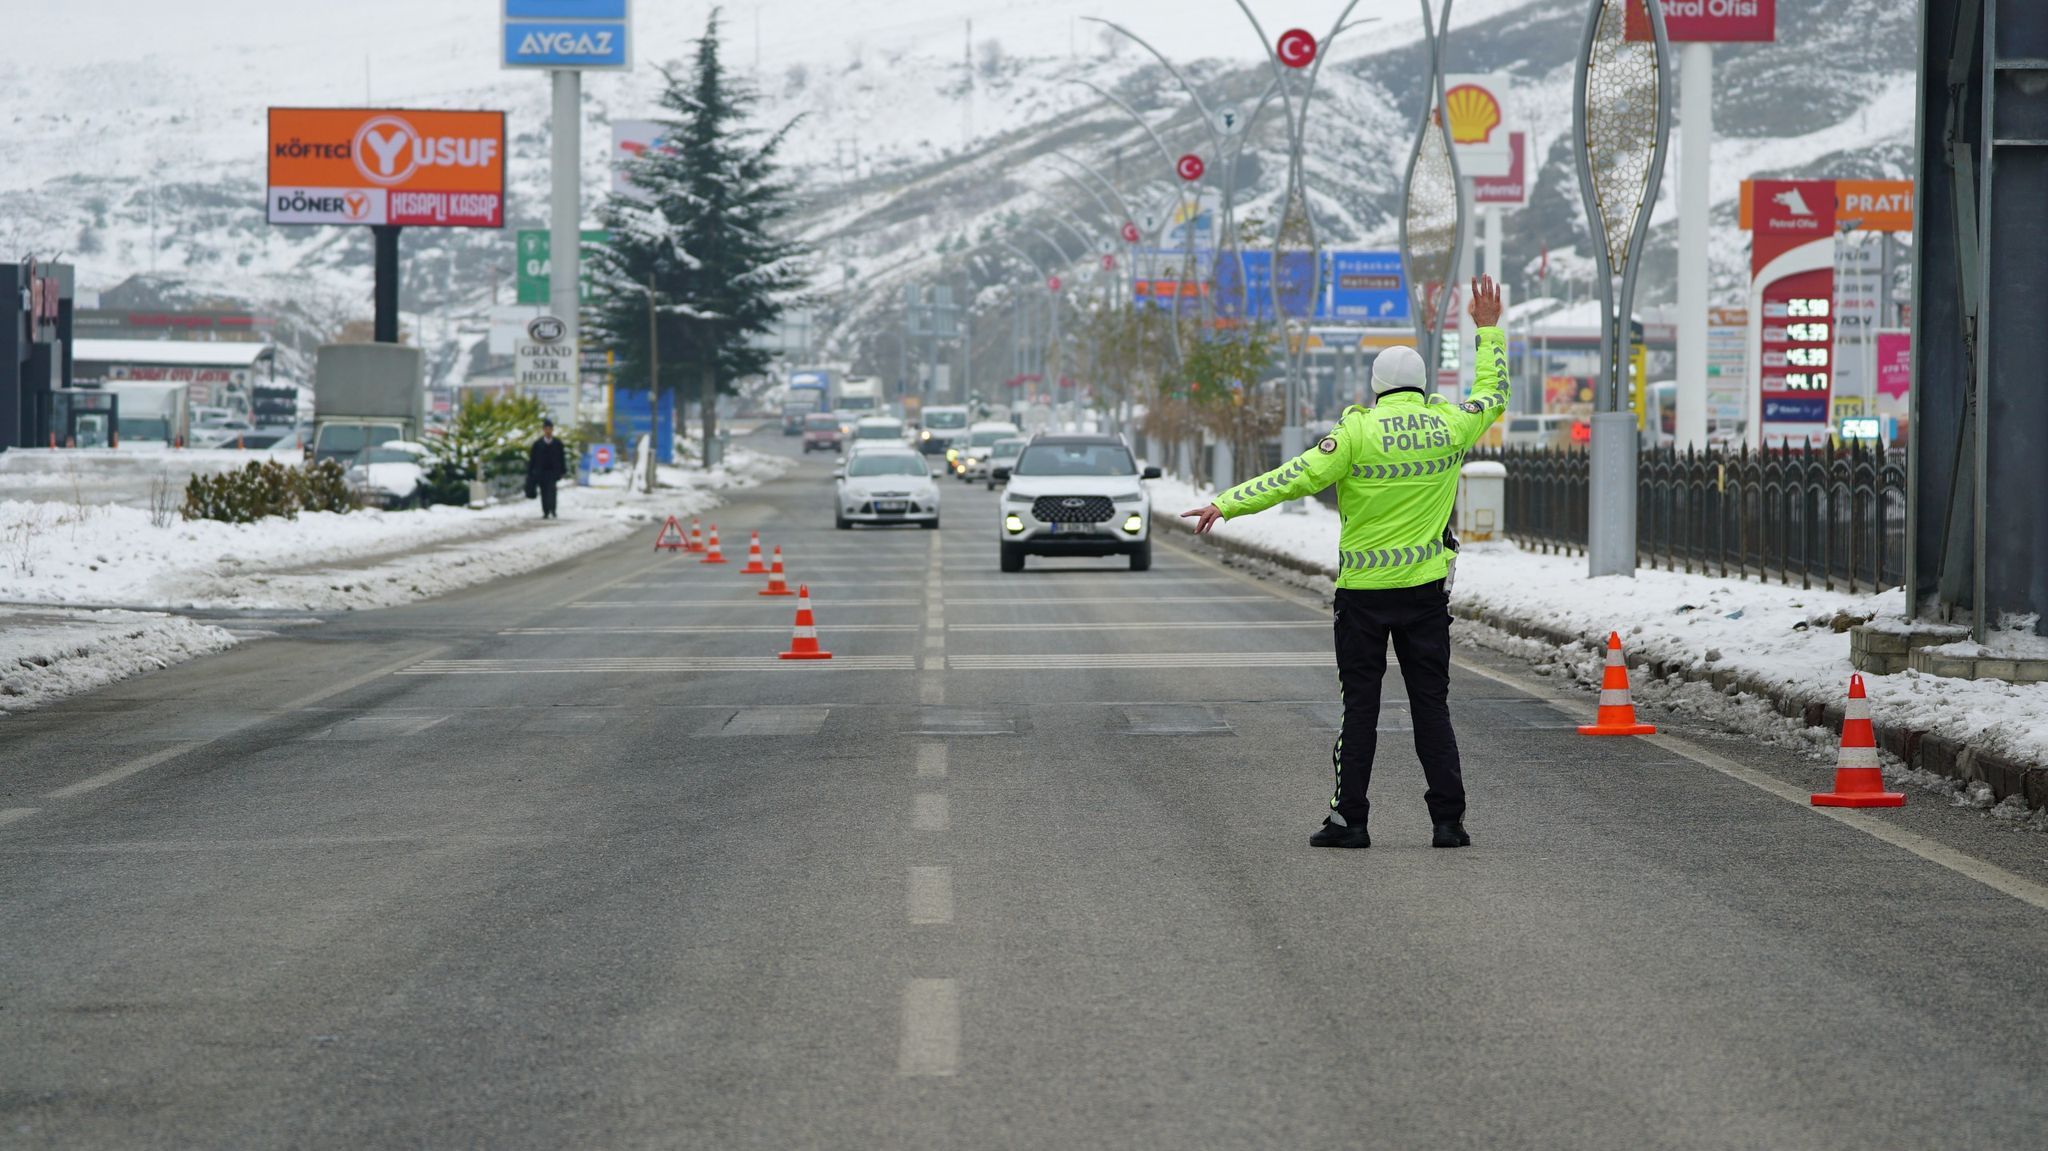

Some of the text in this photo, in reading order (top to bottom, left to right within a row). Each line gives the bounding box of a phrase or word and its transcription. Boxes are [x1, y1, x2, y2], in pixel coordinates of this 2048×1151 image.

[1659, 0, 1703, 16] etrol
[517, 32, 612, 54] AYGAZ
[275, 138, 352, 159] KÖFTECİ
[278, 191, 344, 212] DÖNER
[449, 193, 498, 222] KASAP
[1845, 189, 1913, 212] PRATİ
[1769, 219, 1818, 229] Petrol Ofisi
[520, 346, 572, 357] GRAND
[533, 359, 560, 370] SER
[522, 372, 568, 383] HOTEL
